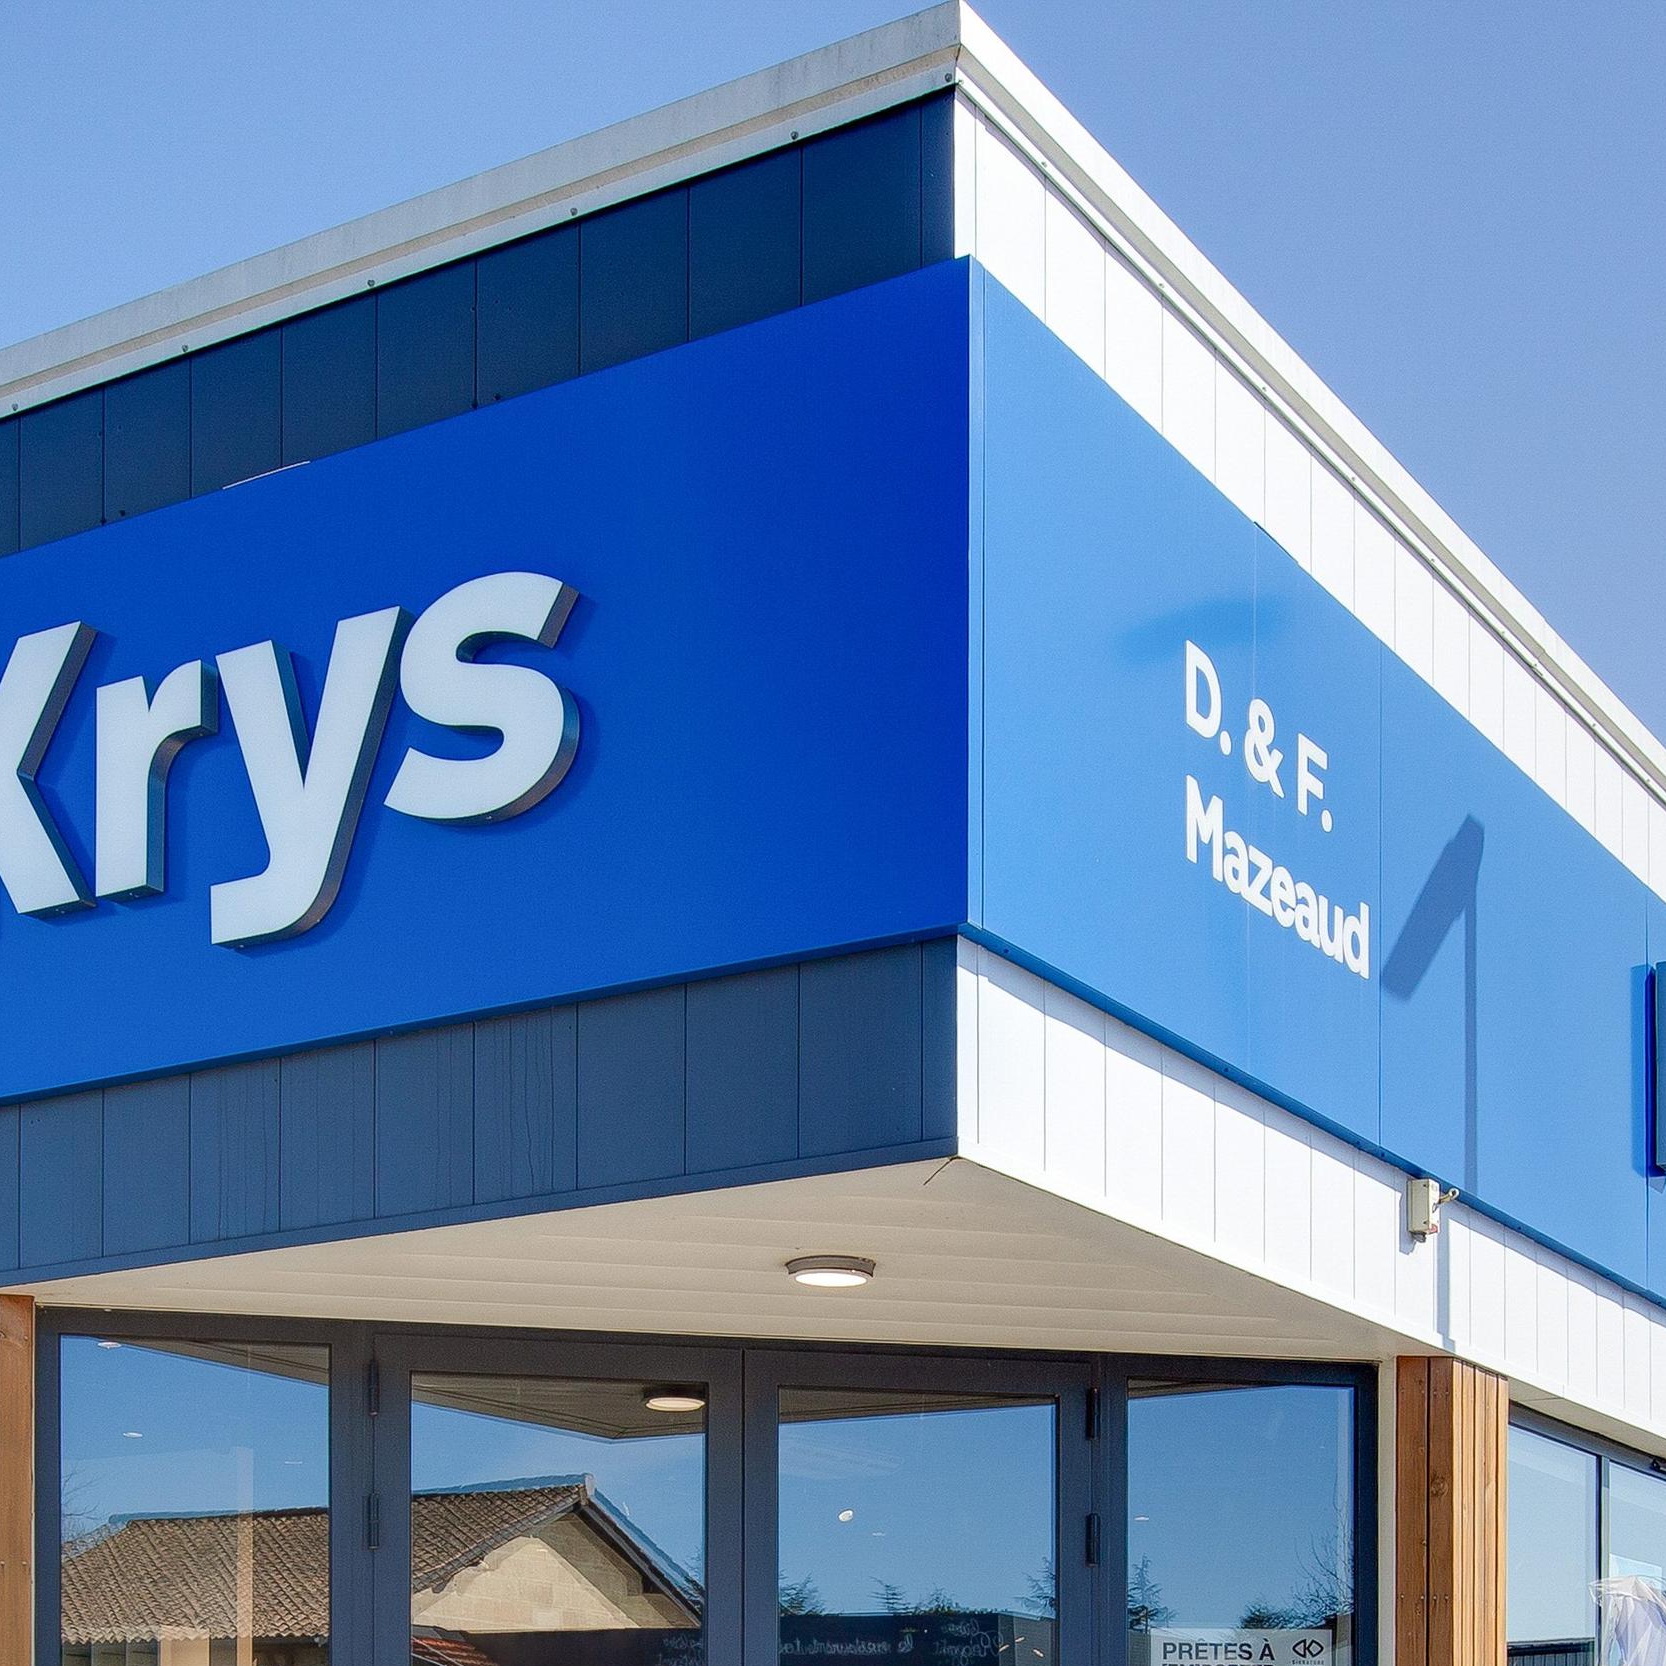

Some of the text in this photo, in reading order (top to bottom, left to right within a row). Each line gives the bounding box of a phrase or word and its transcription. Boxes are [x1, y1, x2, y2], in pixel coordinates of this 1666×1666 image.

[1185, 639, 1334, 833] D. & F.
[1185, 774, 1371, 980] Mazeaud
[1162, 1639, 1276, 1660] PRÊTES À
